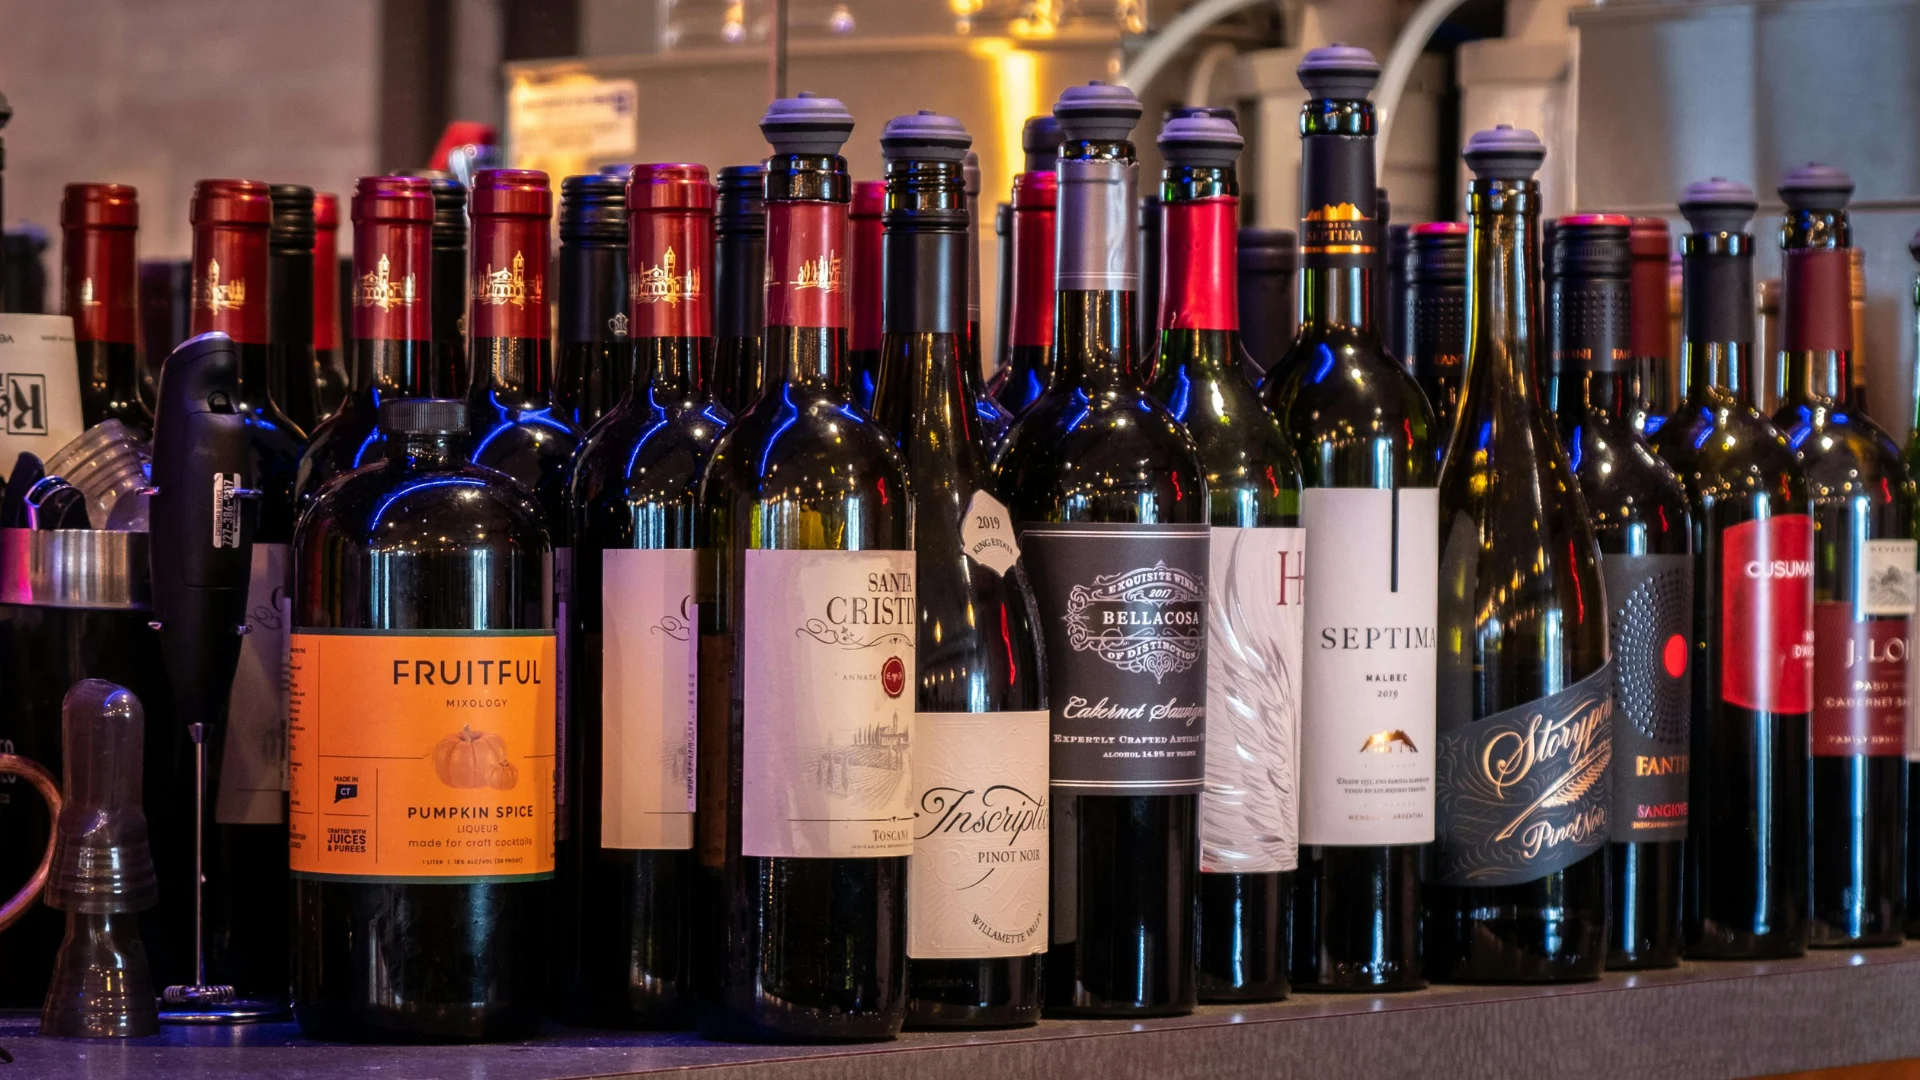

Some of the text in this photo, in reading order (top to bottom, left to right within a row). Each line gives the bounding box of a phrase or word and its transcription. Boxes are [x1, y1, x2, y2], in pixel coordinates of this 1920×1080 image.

[976, 516, 1000, 530] 2019
[972, 538, 1014, 556] KING ESTATE
[868, 572, 912, 593] SANTA
[1108, 571, 1199, 594] EXQUISITE WINES
[1148, 588, 1173, 599] 2017
[1102, 610, 1200, 625] BELLACOSA
[1321, 626, 1436, 650] SEPTIMA
[1107, 641, 1197, 660] OF DISTINCTION
[393, 659, 541, 685] FRUITFUL
[842, 673, 877, 681] ANNATA
[1366, 673, 1408, 682] MALBEC
[1377, 689, 1399, 700] 2019
[446, 699, 508, 708] MIXOLOGY
[1063, 695, 1148, 720] Cabernet
[1053, 734, 1115, 744] EXPERTLY
[1118, 735, 1168, 744] CRAFTED
[340, 788, 351, 796] CT
[407, 805, 533, 819] PUMPKIN SPICE
[457, 824, 499, 833] LIQUEUR
[327, 834, 367, 845] JUICES
[408, 836, 533, 848] made for craft cocktails
[327, 844, 366, 853] & PUREES
[467, 857, 493, 865] ALC/VOL
[978, 849, 1041, 864] PINOT NOIR
[972, 913, 1026, 944] WILLAMETTE
